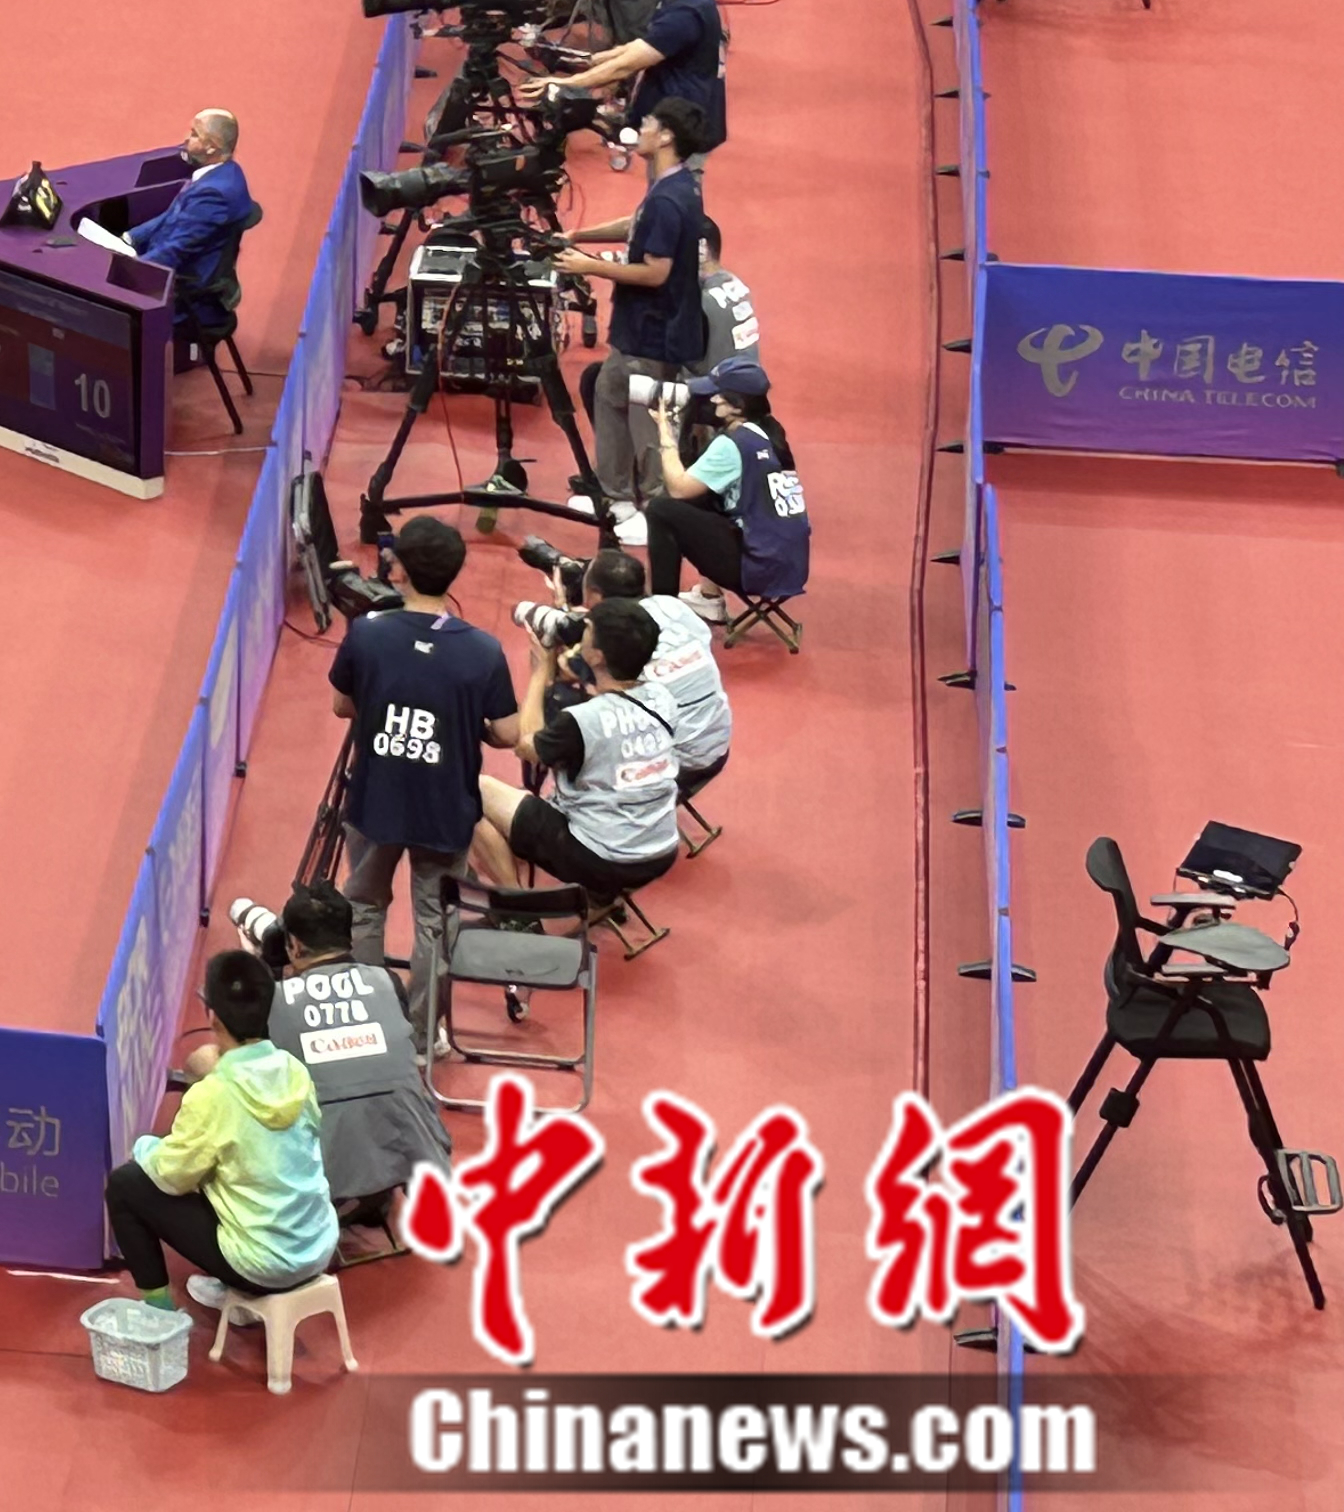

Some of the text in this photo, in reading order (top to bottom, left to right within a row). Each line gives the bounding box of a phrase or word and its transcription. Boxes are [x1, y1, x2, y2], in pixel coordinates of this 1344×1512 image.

[1120, 329, 1320, 388] 中国电信
[73, 372, 111, 420] 10
[1118, 385, 1317, 408] CHINA TELECOM
[384, 702, 437, 741] HB
[282, 967, 375, 1006] POOL
